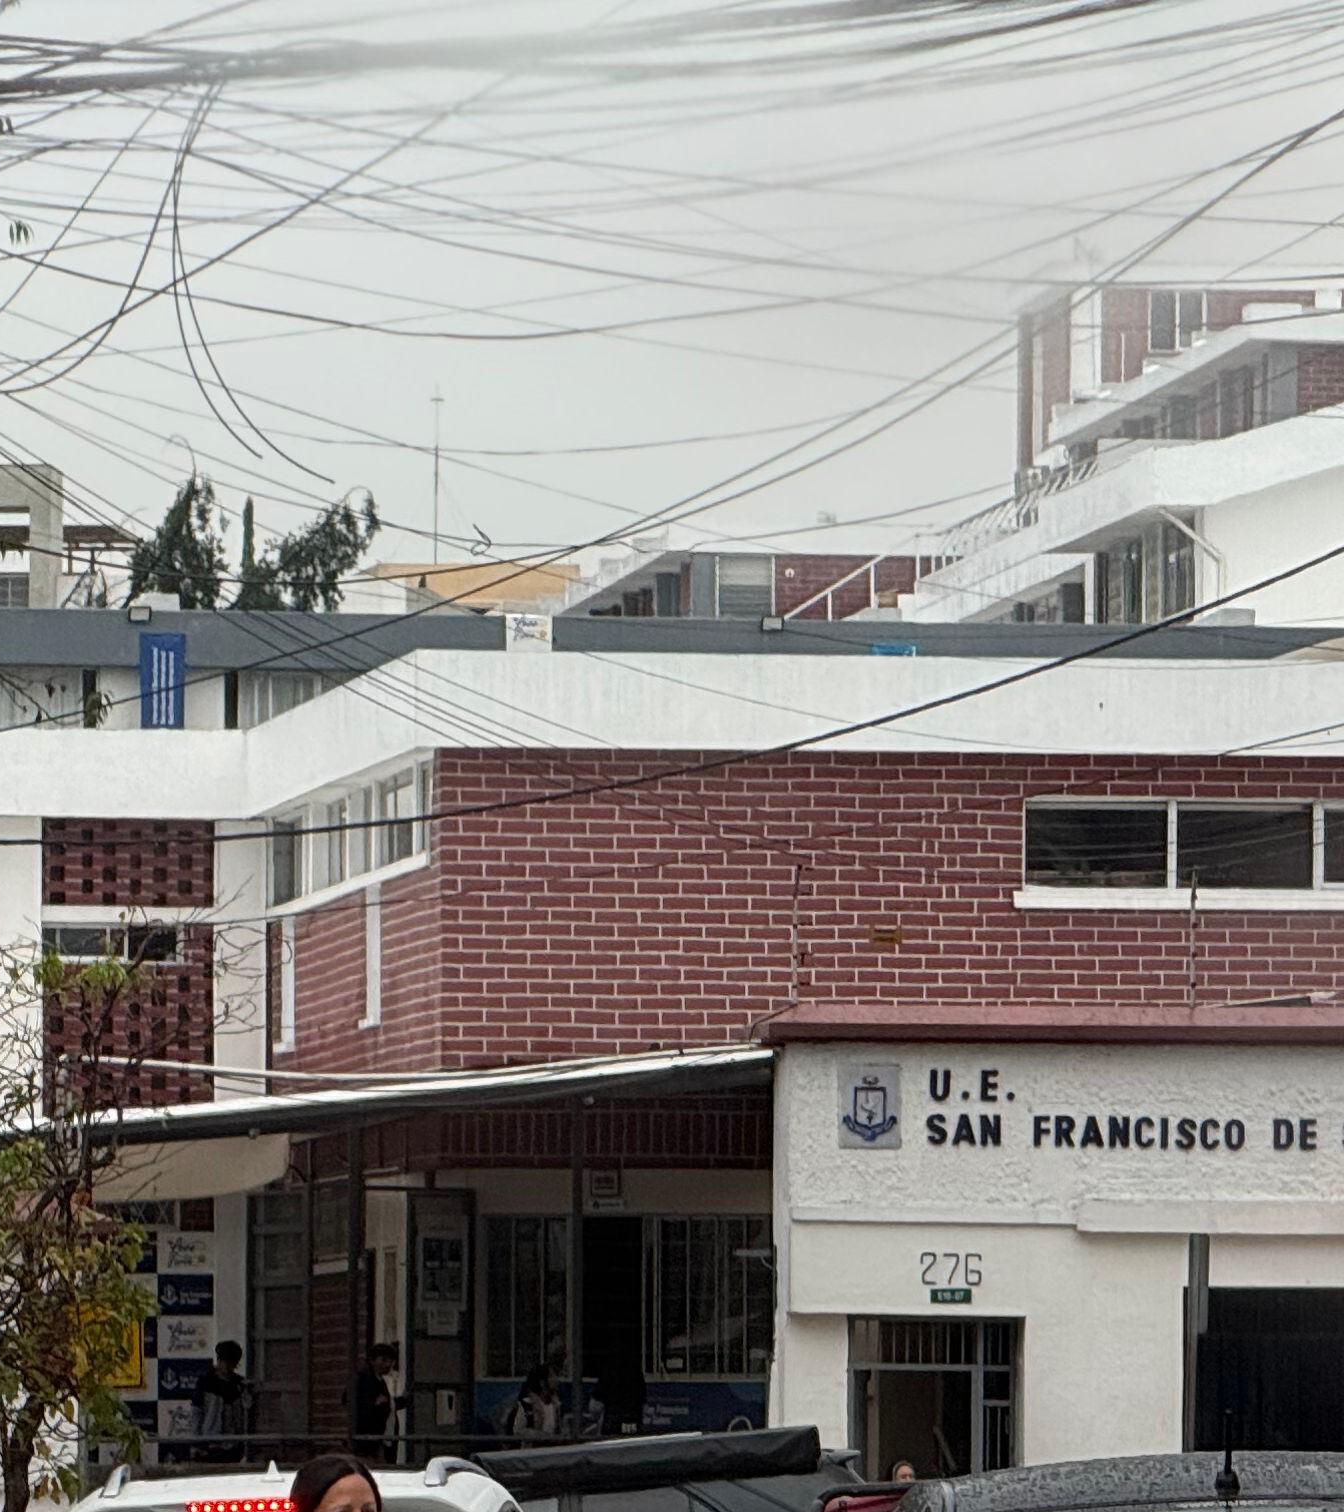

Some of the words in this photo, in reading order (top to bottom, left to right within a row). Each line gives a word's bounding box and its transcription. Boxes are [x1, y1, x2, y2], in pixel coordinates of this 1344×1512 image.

[930, 1069, 1015, 1102] U.E.
[926, 1113, 1001, 1146] SAN
[1033, 1115, 1245, 1151] FRANCISCO
[1272, 1118, 1317, 1151] DE
[920, 1252, 982, 1287] 276
